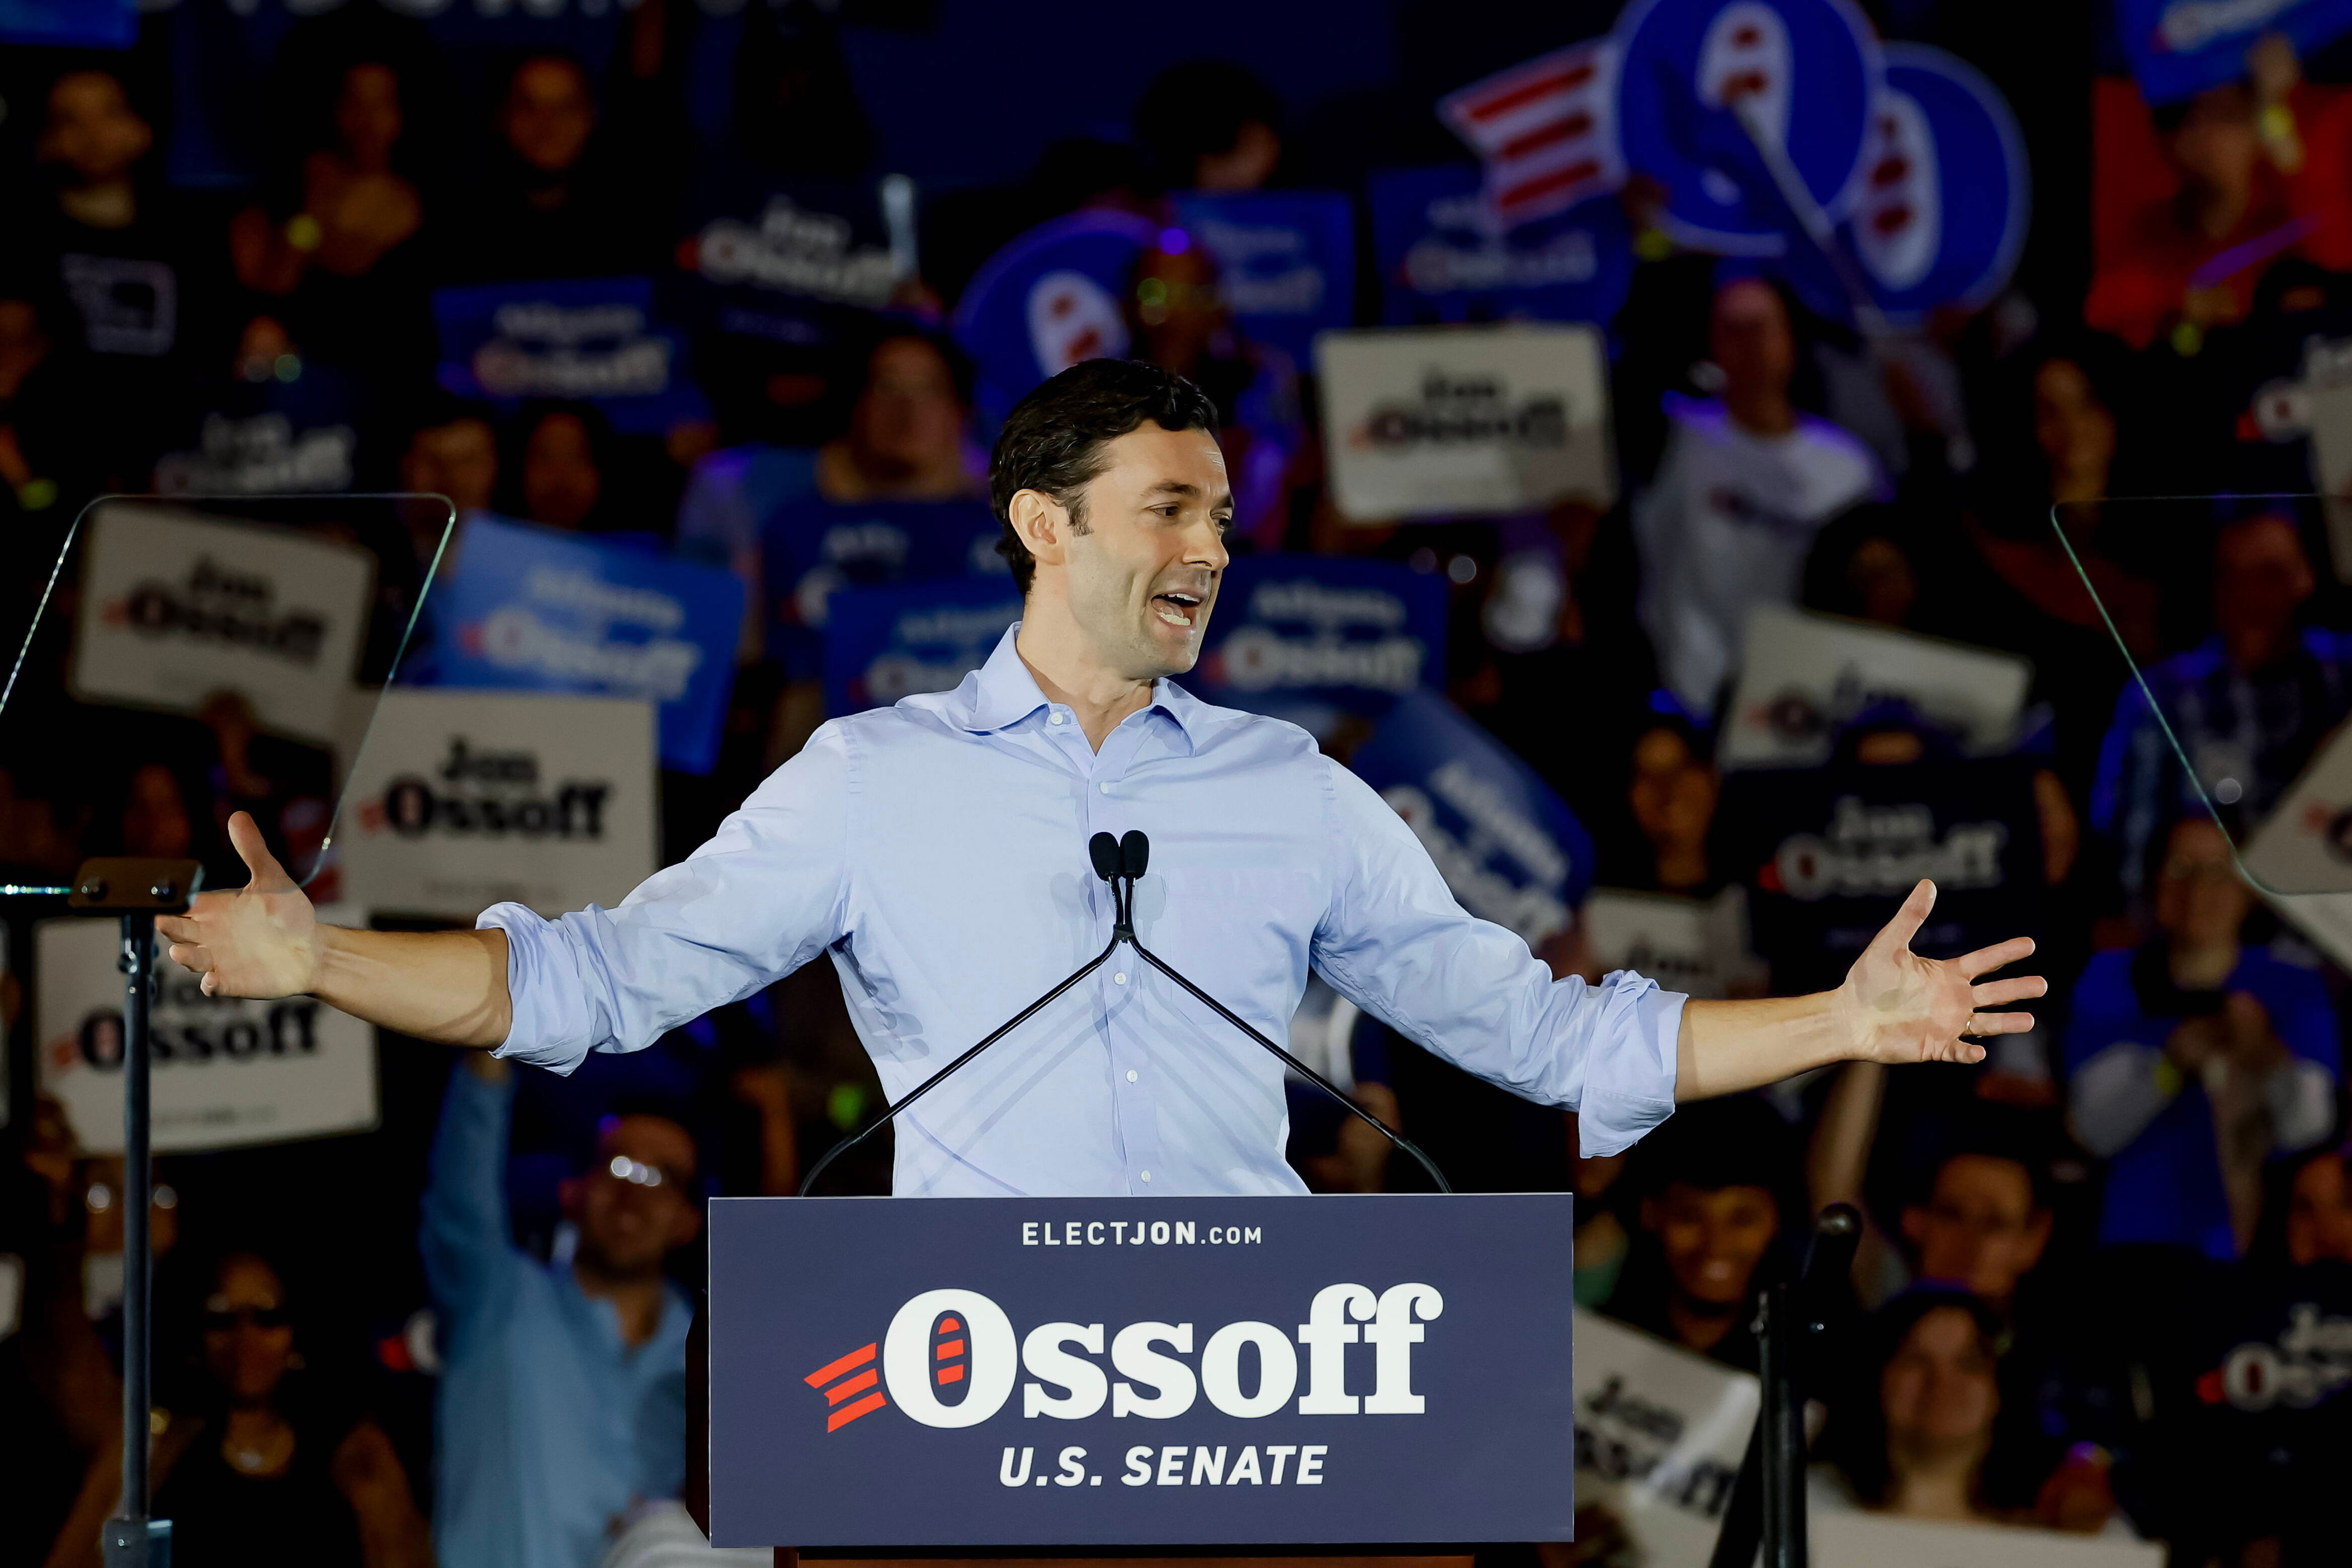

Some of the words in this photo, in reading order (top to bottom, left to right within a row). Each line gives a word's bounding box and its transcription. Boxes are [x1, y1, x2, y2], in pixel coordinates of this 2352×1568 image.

[437, 733, 538, 782] Jon
[384, 771, 612, 837] Ossoff
[883, 1282, 1444, 1429] Ossoff
[999, 1445, 1103, 1487] U.S.
[1121, 1444, 1328, 1486] SENATE
